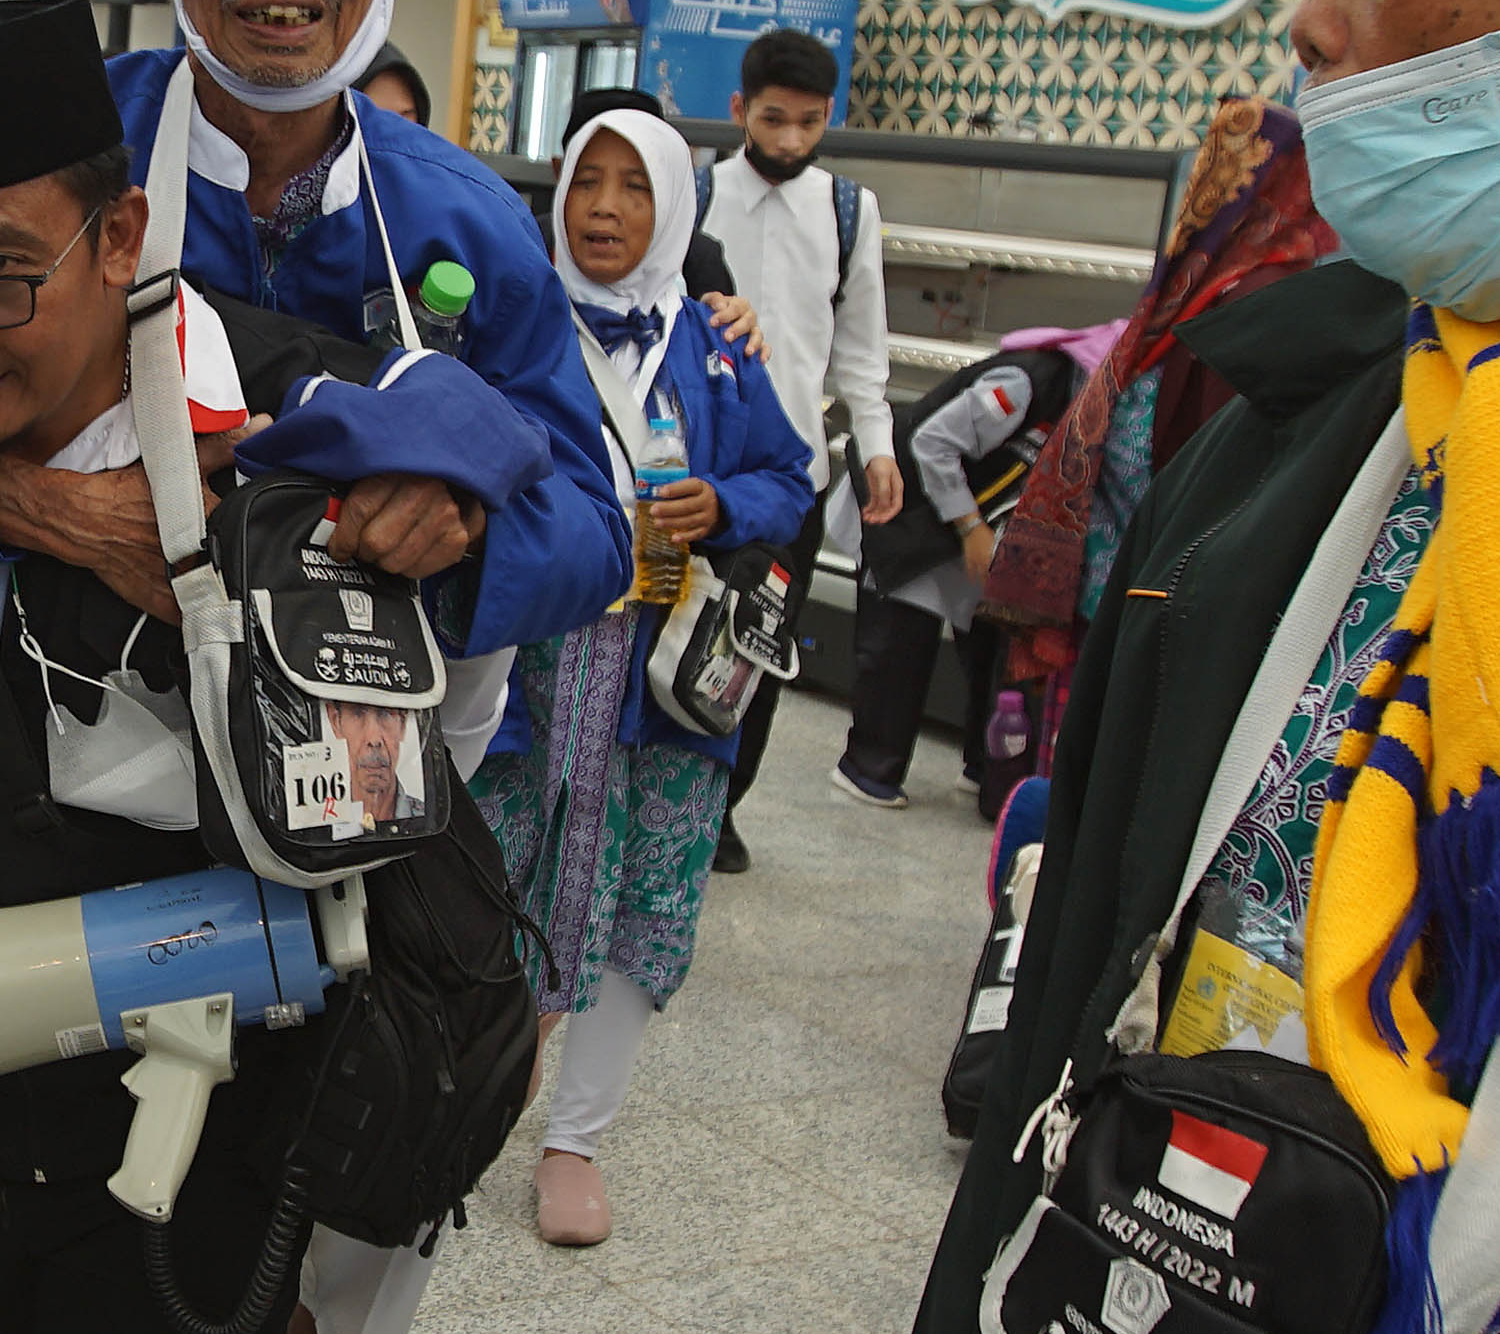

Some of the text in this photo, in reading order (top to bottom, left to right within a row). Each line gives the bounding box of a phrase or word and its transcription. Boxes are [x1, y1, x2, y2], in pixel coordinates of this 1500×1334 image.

[344, 667, 393, 687] SAUDIA
[293, 771, 346, 807] 106
[1132, 1185, 1235, 1258] INDONESIA
[1097, 1202, 1140, 1244] 1443
[1134, 1227, 1158, 1256] H
[1163, 1245, 1222, 1295] 2022
[1228, 1275, 1255, 1308] M
